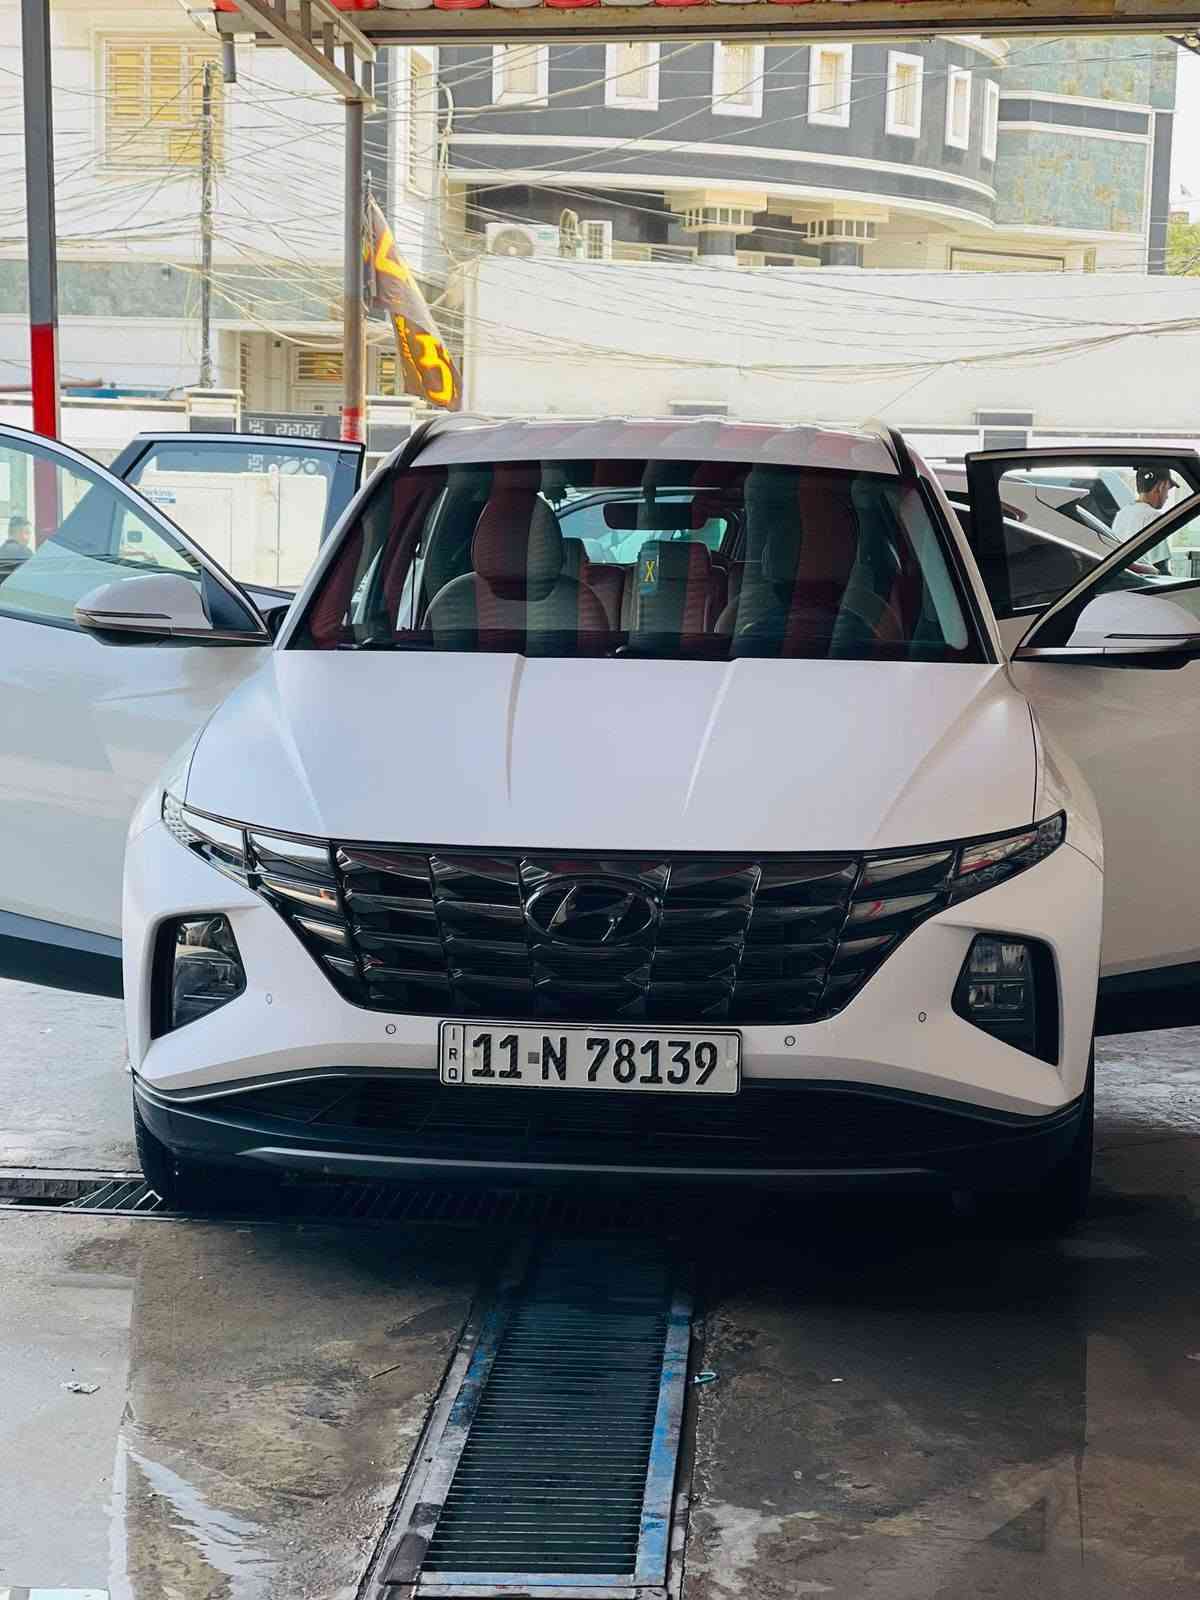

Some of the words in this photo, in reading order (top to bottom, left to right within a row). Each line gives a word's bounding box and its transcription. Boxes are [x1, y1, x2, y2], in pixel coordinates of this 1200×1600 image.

[448, 1027, 459, 1080] IRQ
[472, 1033, 522, 1079] 11
[541, 1036, 567, 1081] N
[586, 1037, 718, 1086] 78139
